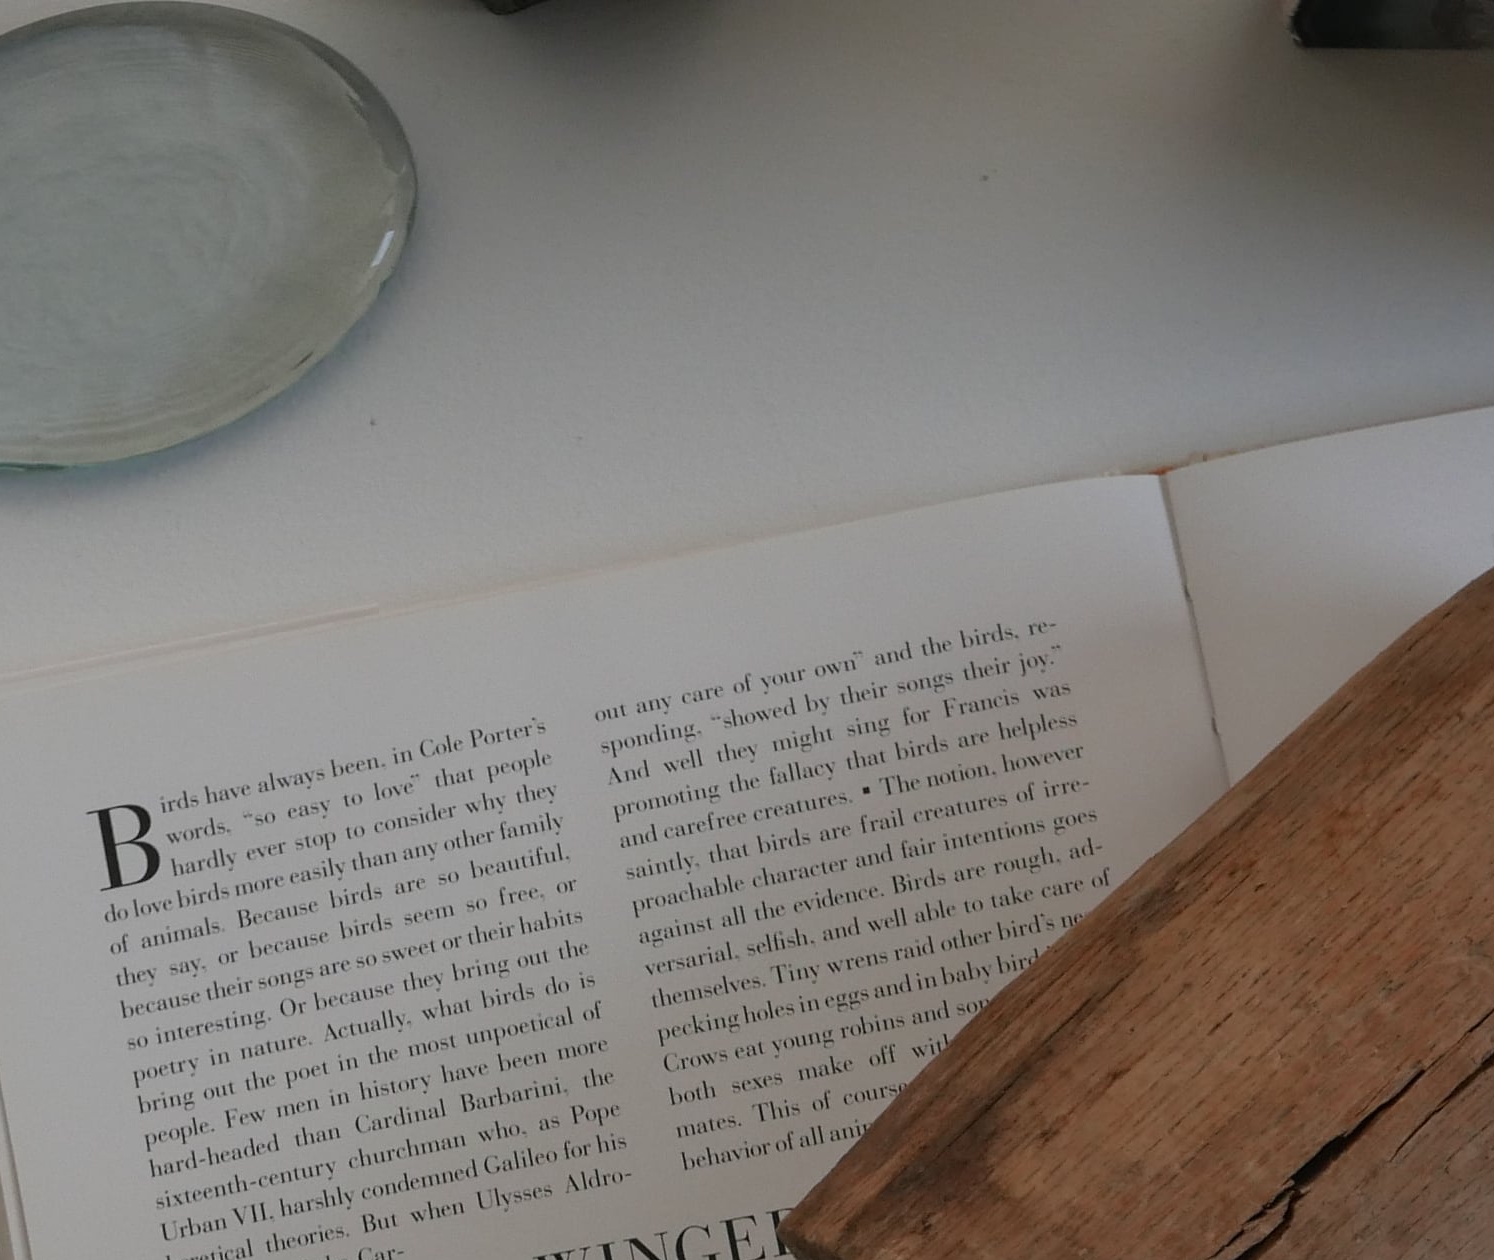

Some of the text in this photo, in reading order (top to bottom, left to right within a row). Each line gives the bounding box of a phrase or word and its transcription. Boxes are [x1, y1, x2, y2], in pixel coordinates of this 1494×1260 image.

[594, 704, 627, 722] out
[636, 695, 672, 715] any
[681, 685, 724, 704] care
[732, 672, 752, 694] of
[760, 668, 806, 695] your
[874, 640, 913, 666] and
[921, 636, 952, 657] the
[959, 623, 1020, 649] birds,
[1028, 621, 1057, 636] re-
[600, 723, 702, 759] sponding,
[803, 693, 830, 716] by
[839, 681, 888, 705] their
[896, 672, 954, 694] songs
[962, 657, 1011, 681] their
[85, 804, 161, 892] B
[160, 790, 200, 814] irds
[204, 784, 251, 805] have
[257, 770, 326, 793] always
[330, 757, 386, 778] been,
[392, 747, 413, 765] in
[419, 734, 464, 758] Cole
[165, 816, 231, 844] words,
[287, 799, 331, 819] easy
[343, 793, 364, 808] to
[434, 767, 474, 788] that
[486, 748, 552, 785] people
[170, 783, 557, 877] hardly ever stop to consider why they
[104, 811, 564, 923] do love birds more easily than any other family
[160, 1132, 628, 1242] Urban VII, harshly condemned Galileo for his
